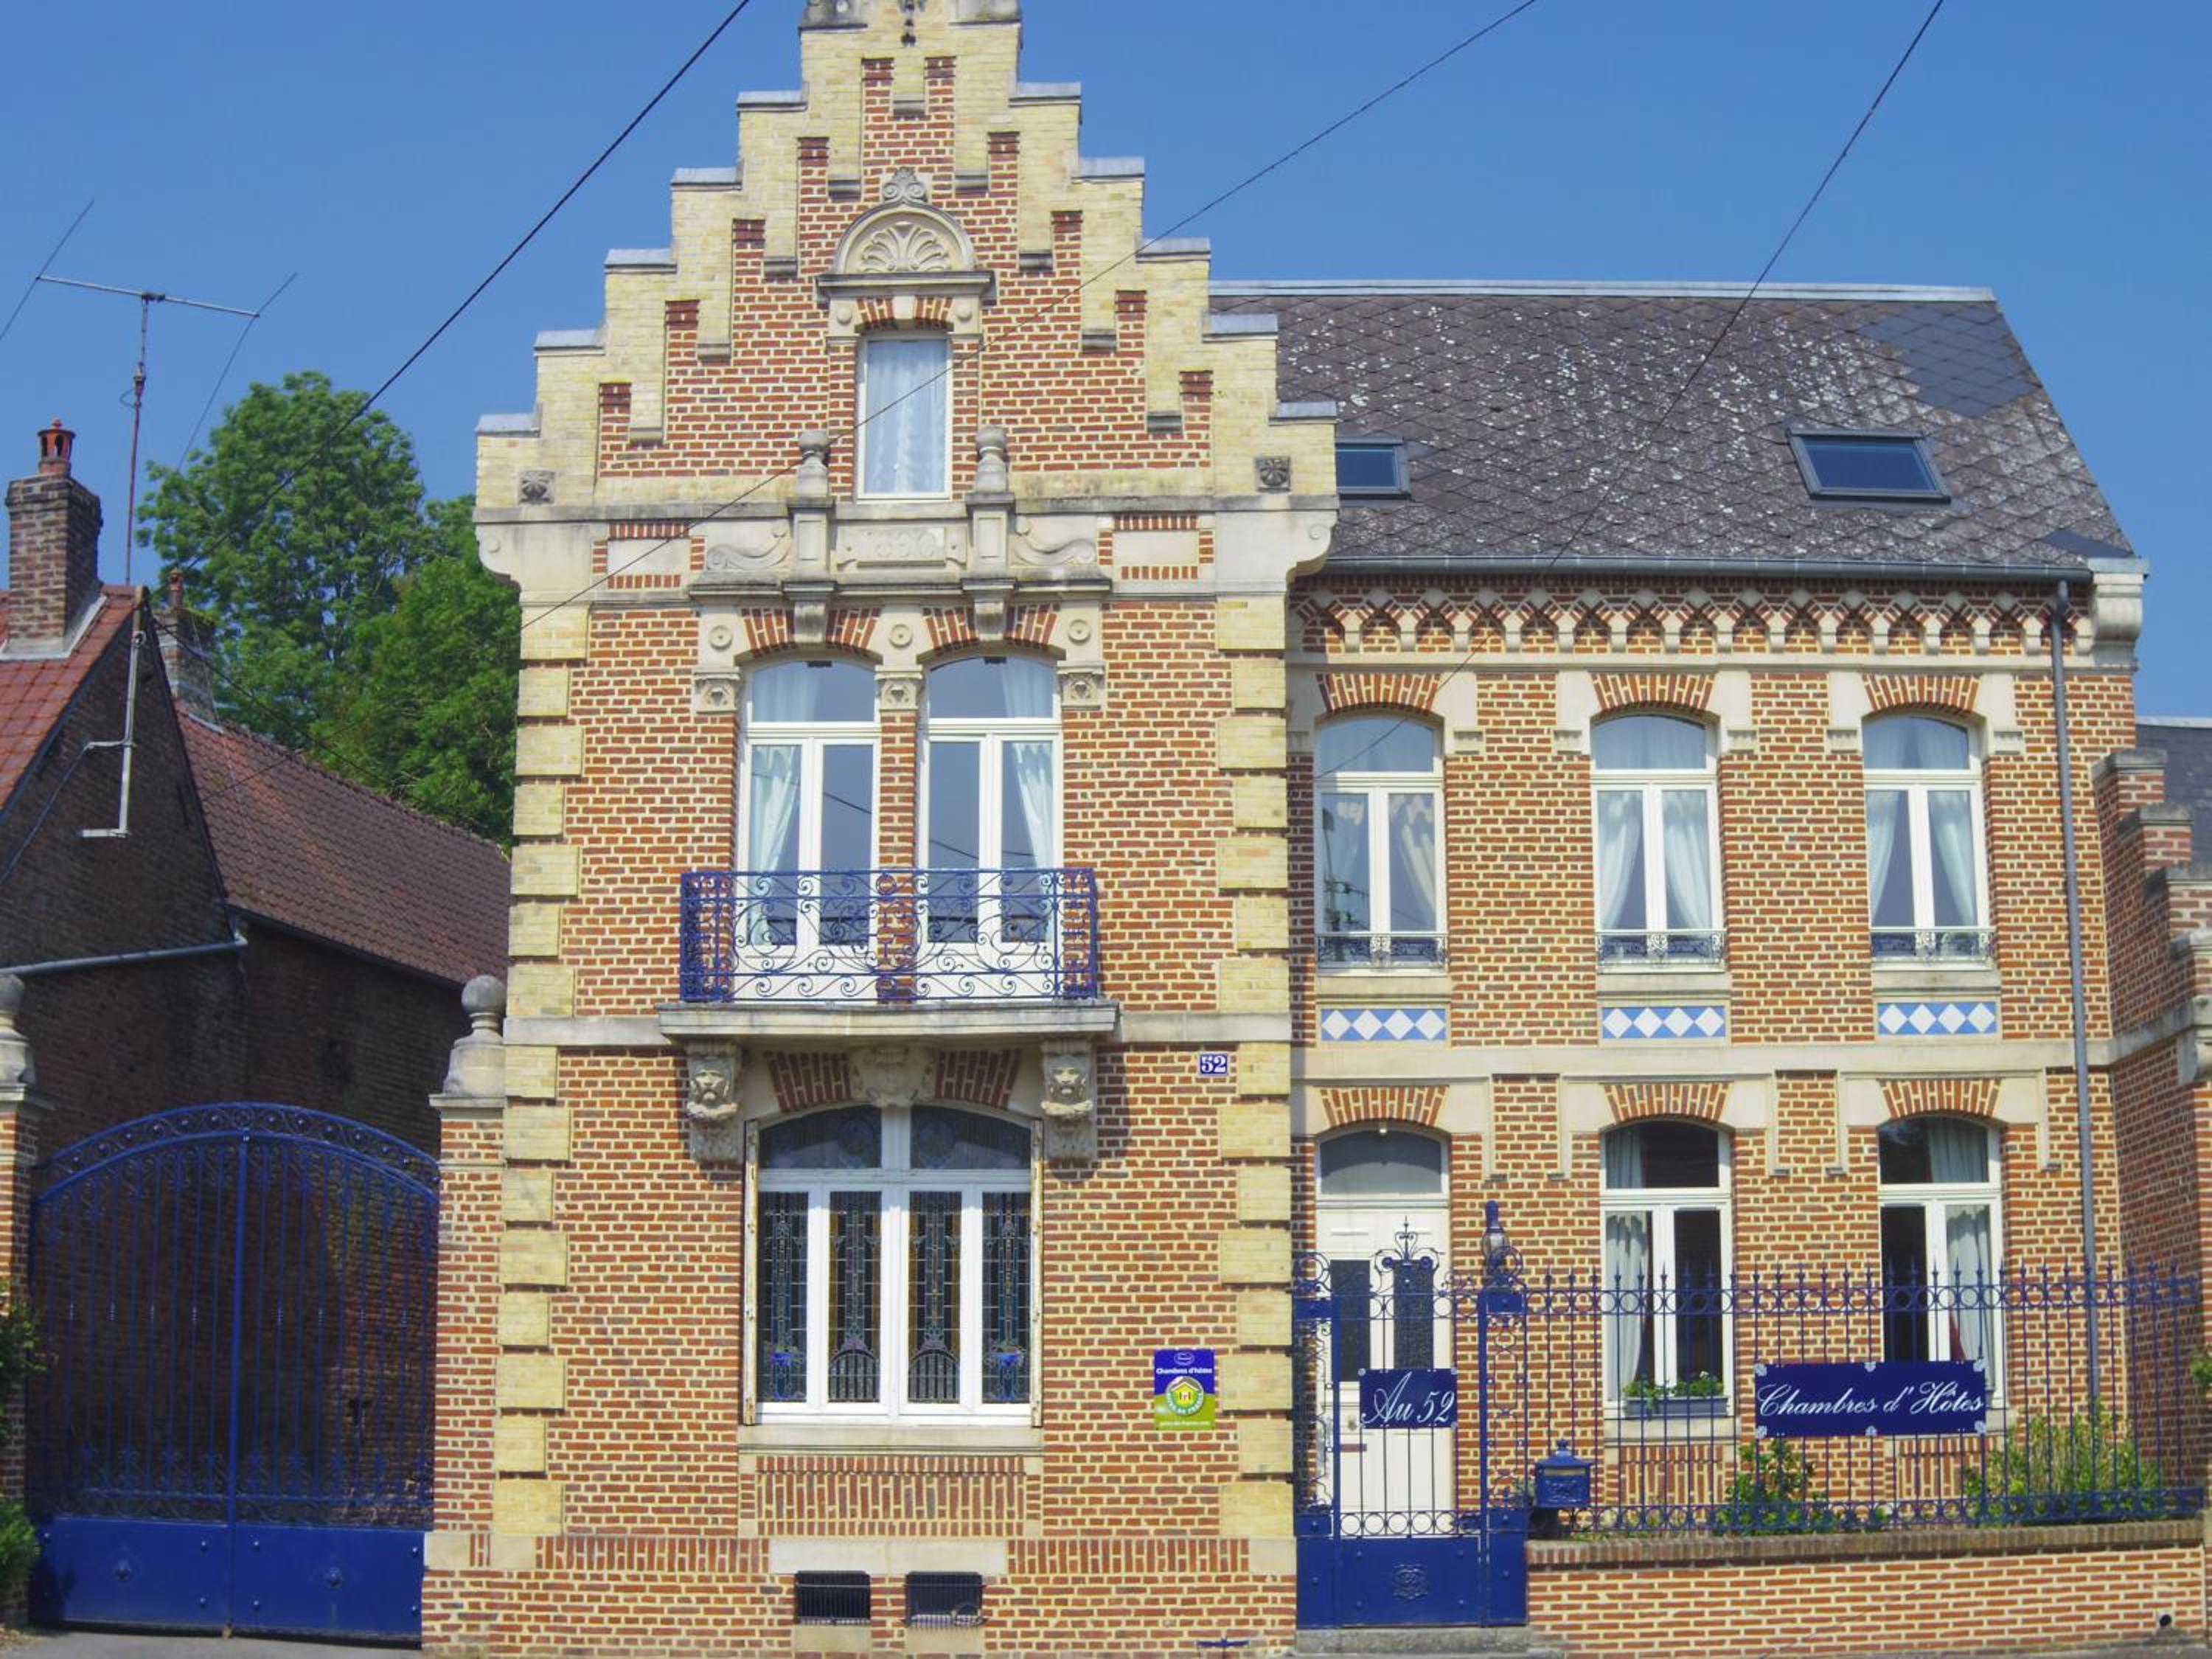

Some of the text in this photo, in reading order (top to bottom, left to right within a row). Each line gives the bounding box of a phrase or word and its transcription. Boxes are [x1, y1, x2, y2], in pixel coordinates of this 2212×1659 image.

[1201, 1055, 1226, 1073] 52
[1361, 1371, 1455, 1424] Au 52
[1757, 1380, 1985, 1416] Chambres d'Hôtes
